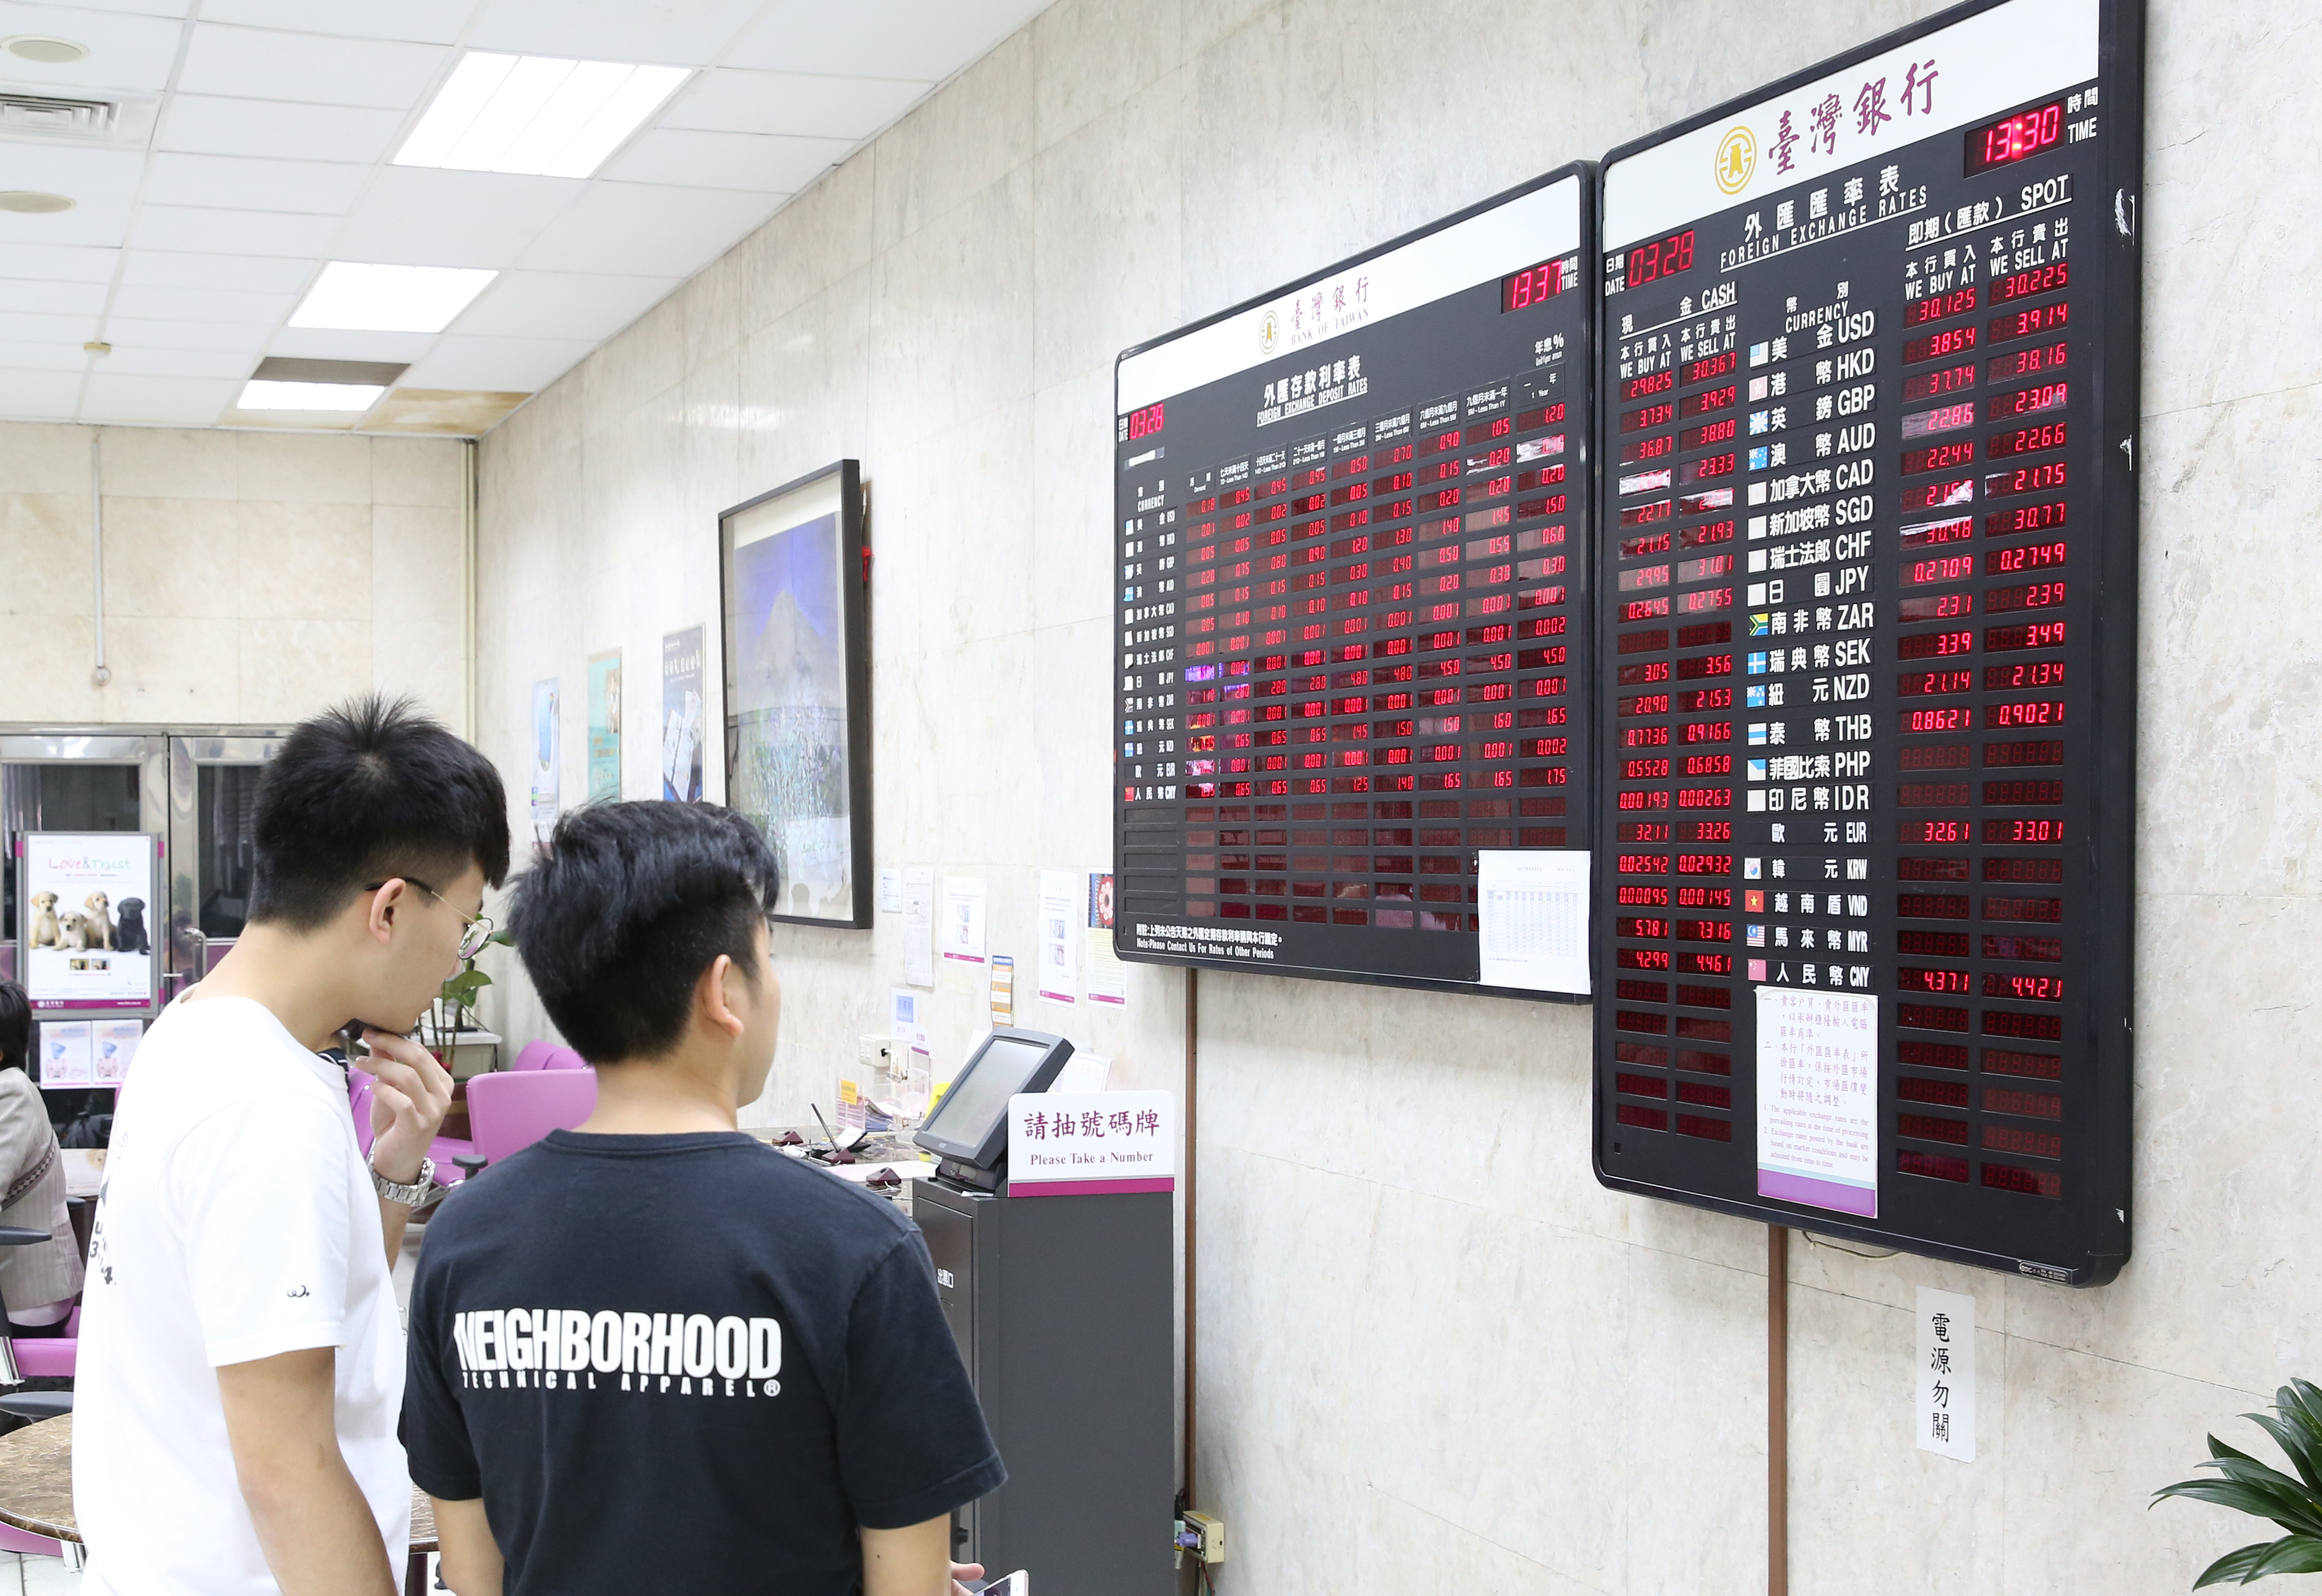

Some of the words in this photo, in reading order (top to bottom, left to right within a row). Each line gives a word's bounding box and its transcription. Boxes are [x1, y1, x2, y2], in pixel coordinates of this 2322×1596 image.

[2067, 88, 2098, 113] 時間
[1769, 59, 1939, 175] 臺灣銀行
[2068, 118, 2097, 143] TIME
[1744, 165, 1899, 240] 外匯匯率表
[2021, 176, 2068, 209] SPOT
[1721, 235, 1779, 269] FOREIGN
[1791, 206, 1866, 246] EXCHANGE
[1879, 186, 1928, 216] RATES
[1990, 217, 2068, 254] 本行賣出
[1562, 256, 1578, 274] 時間
[1606, 254, 1624, 273] 日期
[1629, 230, 1694, 287] 0328
[1905, 244, 1976, 278] 本行買入
[1990, 258, 2008, 277] WE
[2015, 245, 2044, 270] SELL
[2051, 238, 2068, 260] AT
[1561, 272, 1578, 291] TIME
[1605, 276, 1625, 296] DATE
[1905, 282, 1922, 301] WE
[1930, 270, 1954, 294] BUY
[1960, 265, 1976, 285] AT
[2005, 263, 2068, 298] 30.225
[1292, 276, 1369, 331] 臺灣銀行
[1702, 283, 1735, 310] CASH
[1919, 288, 1976, 322] 30.125
[1292, 328, 1313, 345] BANK
[1318, 322, 1328, 335] OF
[1335, 307, 1369, 330] TAIWAN
[1680, 314, 1736, 343] 本行賣出
[1786, 301, 1848, 333] CURRENCY
[1838, 310, 1874, 343] USD
[2017, 304, 2068, 334] 3.914
[1620, 333, 1671, 361] 本行買入
[1681, 344, 1693, 363] WE
[1698, 336, 1719, 359] SELL
[1723, 332, 1736, 350] AT
[2017, 343, 2066, 373] 38.16
[1621, 361, 1633, 380] WE
[1637, 355, 1655, 375] BUY
[1660, 350, 1671, 369] AT
[1837, 348, 1874, 381] HKD
[1264, 354, 1361, 408] 外匯存款利率表
[1538, 388, 1549, 397] Year
[1257, 405, 1281, 424] FOREIGN
[1285, 394, 1315, 415] EXCHANGE
[1318, 385, 1344, 404] DEPOSIT
[1348, 377, 1367, 395] RATES
[1489, 402, 1499, 411] Than
[1837, 384, 1874, 415] GBP
[1119, 429, 1128, 442] DATE
[1130, 403, 1164, 439] 0328
[1837, 422, 1875, 454] AUD
[1770, 468, 1830, 503] 加拿大幣
[1836, 459, 1873, 490] CAD
[1138, 495, 1164, 512] CURRENCY
[1769, 504, 1830, 536] 新加坡幣
[1835, 495, 1873, 526] SGD
[1770, 539, 1830, 570] 瑞士法郎
[1835, 530, 1871, 561] CHF
[2000, 543, 2065, 570] 0.2749
[1835, 565, 1868, 595] JPY
[1771, 607, 1833, 635] 南非幣
[1837, 602, 1874, 631] ZAR
[1835, 637, 1871, 666] SEK
[1834, 673, 1870, 702] NZD
[1835, 714, 1872, 741] THB
[1911, 710, 1970, 731] 0.8621
[1999, 703, 2063, 726] 0.9021
[1769, 755, 1830, 780] 菲國比索
[1835, 750, 1871, 778] PHP
[1835, 785, 1870, 810] IDR
[1846, 821, 1866, 843] EUR
[1925, 822, 1970, 841] 32.61
[2012, 821, 2063, 840] 33.01
[1847, 859, 1867, 879] KRW
[1847, 895, 1867, 917] VND
[1167, 940, 1187, 952] Contact
[1189, 943, 1196, 953] Us
[1198, 943, 1207, 954] For
[1209, 944, 1224, 955] Rates
[1227, 945, 1232, 956] of
[1235, 946, 1250, 956] Other
[1252, 947, 1274, 959] Periods
[1847, 930, 1868, 952] MYR
[1849, 965, 1869, 987] CNY
[1924, 972, 1968, 991] 4.371
[2012, 976, 2062, 998] 4.421
[1024, 1109, 1160, 1140] 請抽號碼牌
[1769, 1117, 1793, 1127] prevailing
[1842, 1129, 1868, 1140] processing
[1783, 1108, 1807, 1117] applicable
[1809, 1112, 1832, 1121] exchange
[1030, 1153, 1066, 1166] Please
[1070, 1152, 1095, 1165] Take
[1110, 1150, 1153, 1163] Number
[453, 1308, 782, 1379] NEIGHBORHOOD
[464, 1371, 596, 1390] TECHNICAL
[1931, 1312, 1951, 1444] 電源勿關
